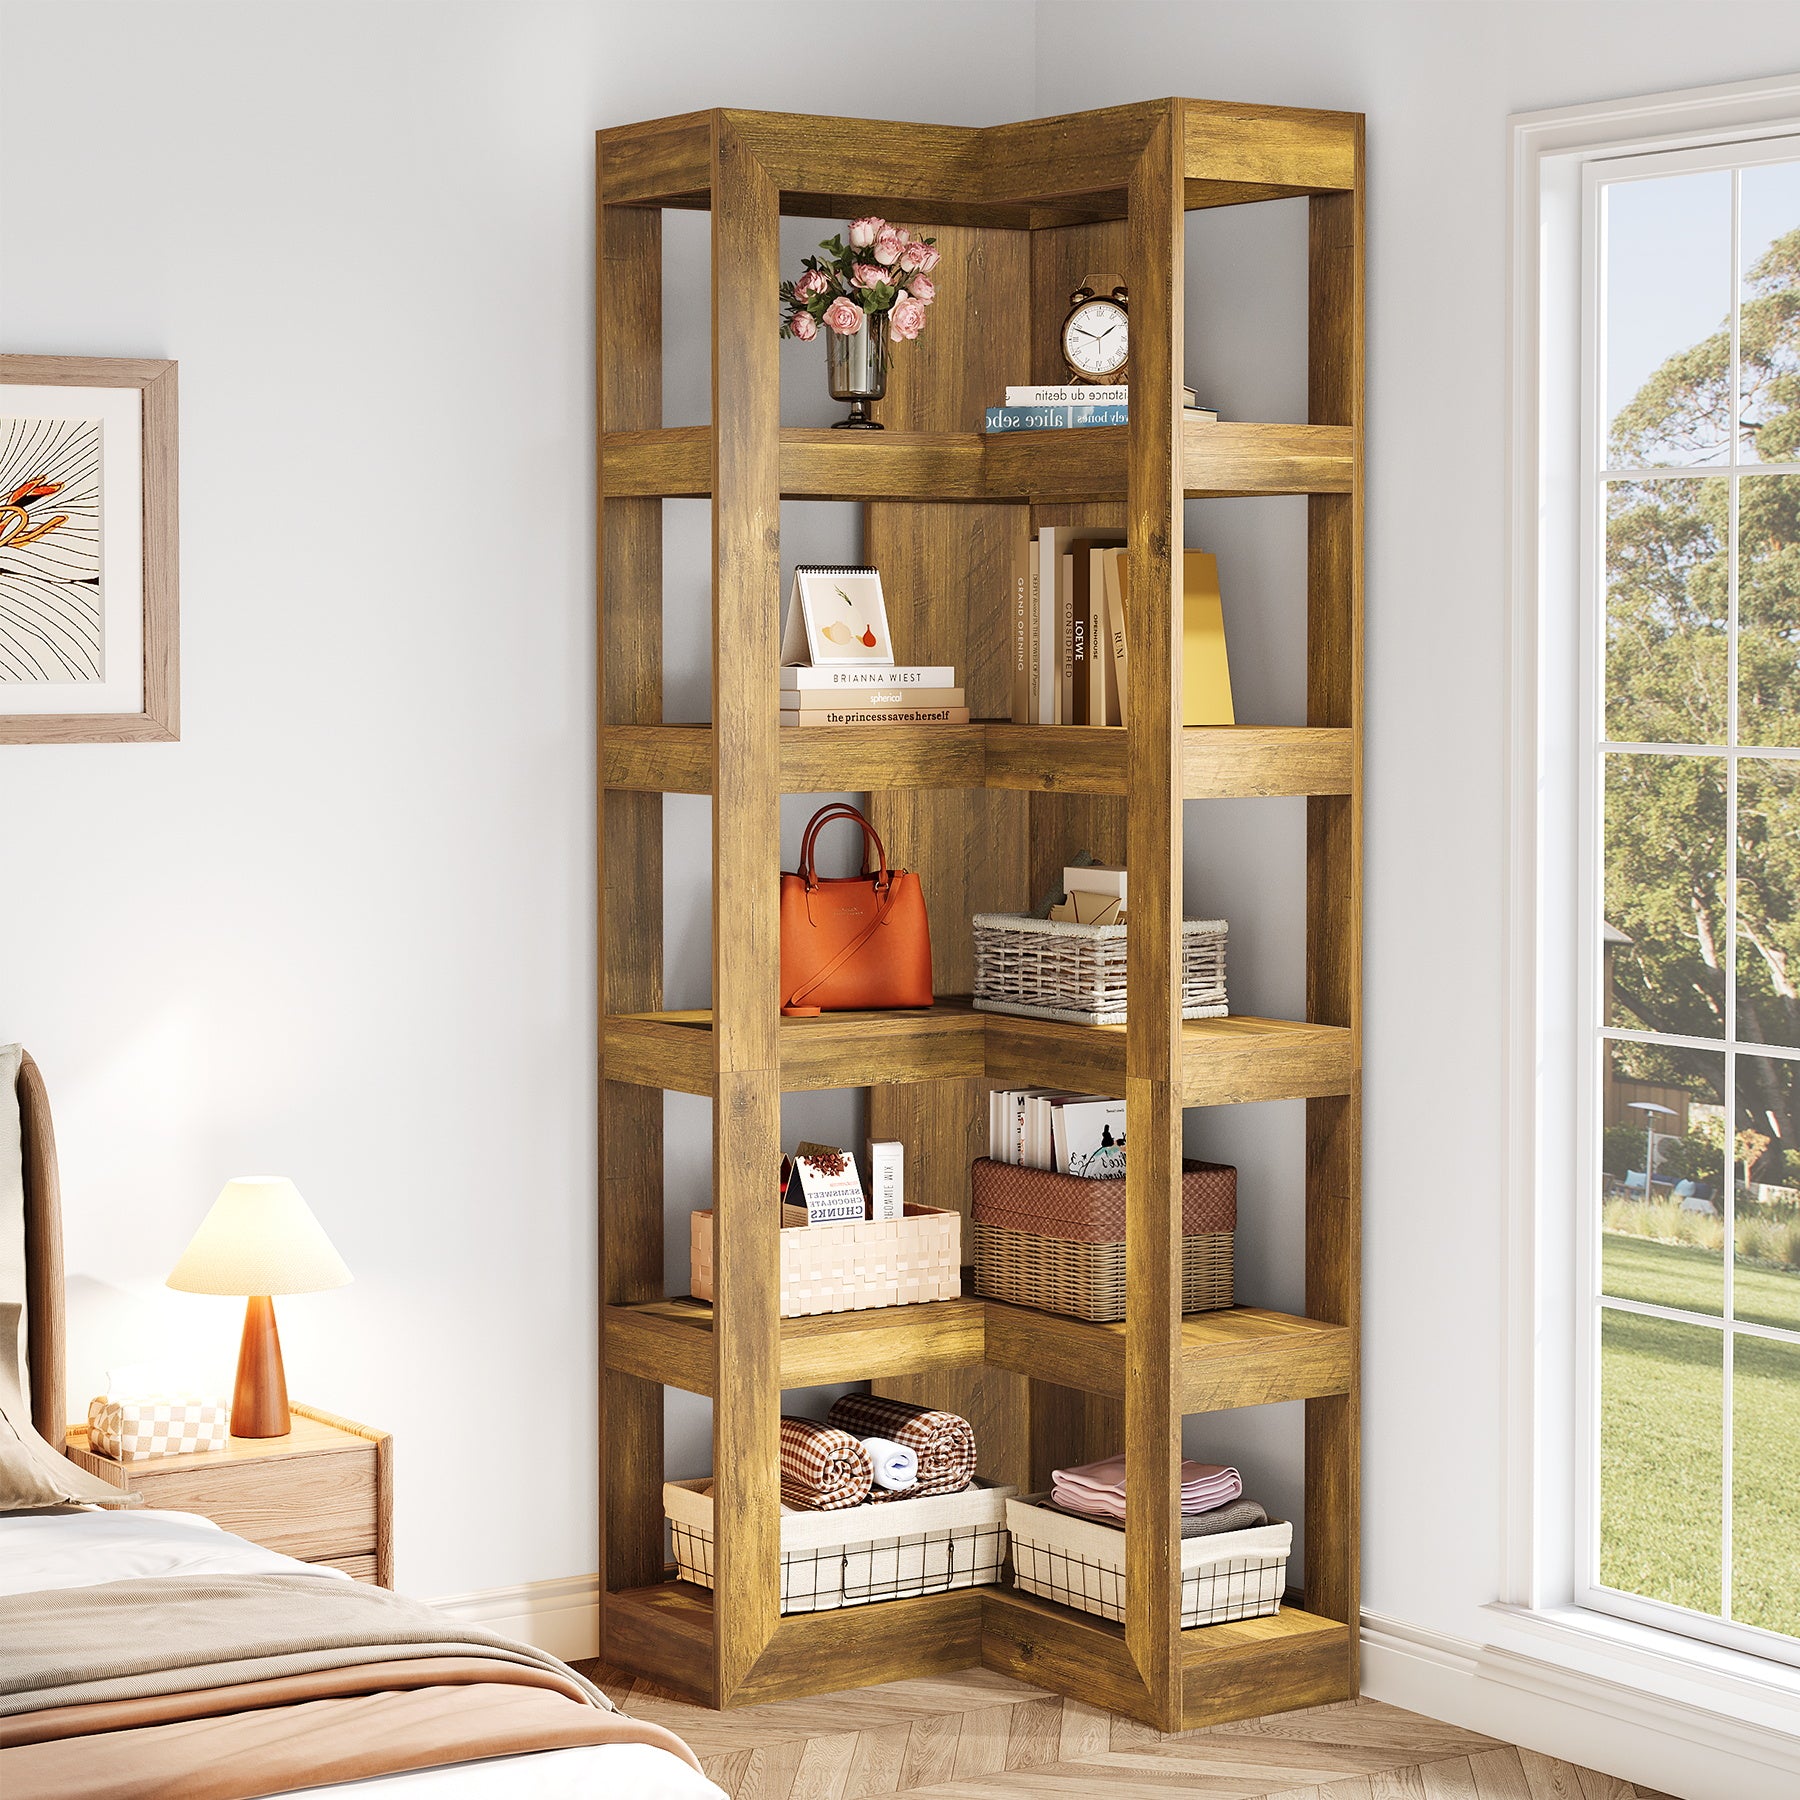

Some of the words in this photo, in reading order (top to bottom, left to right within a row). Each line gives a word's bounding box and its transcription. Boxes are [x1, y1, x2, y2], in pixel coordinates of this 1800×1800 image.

[1065, 602, 1073, 678] CONSIDERED
[1075, 620, 1084, 661] LOEWE
[1114, 631, 1124, 659] RUM
[833, 673, 884, 683] BRIANNA
[889, 673, 922, 682] WIEST
[870, 691, 903, 705] spherical
[827, 713, 844, 723] the
[845, 712, 887, 725] princess
[887, 712, 916, 722] saves
[915, 710, 950, 721] herself
